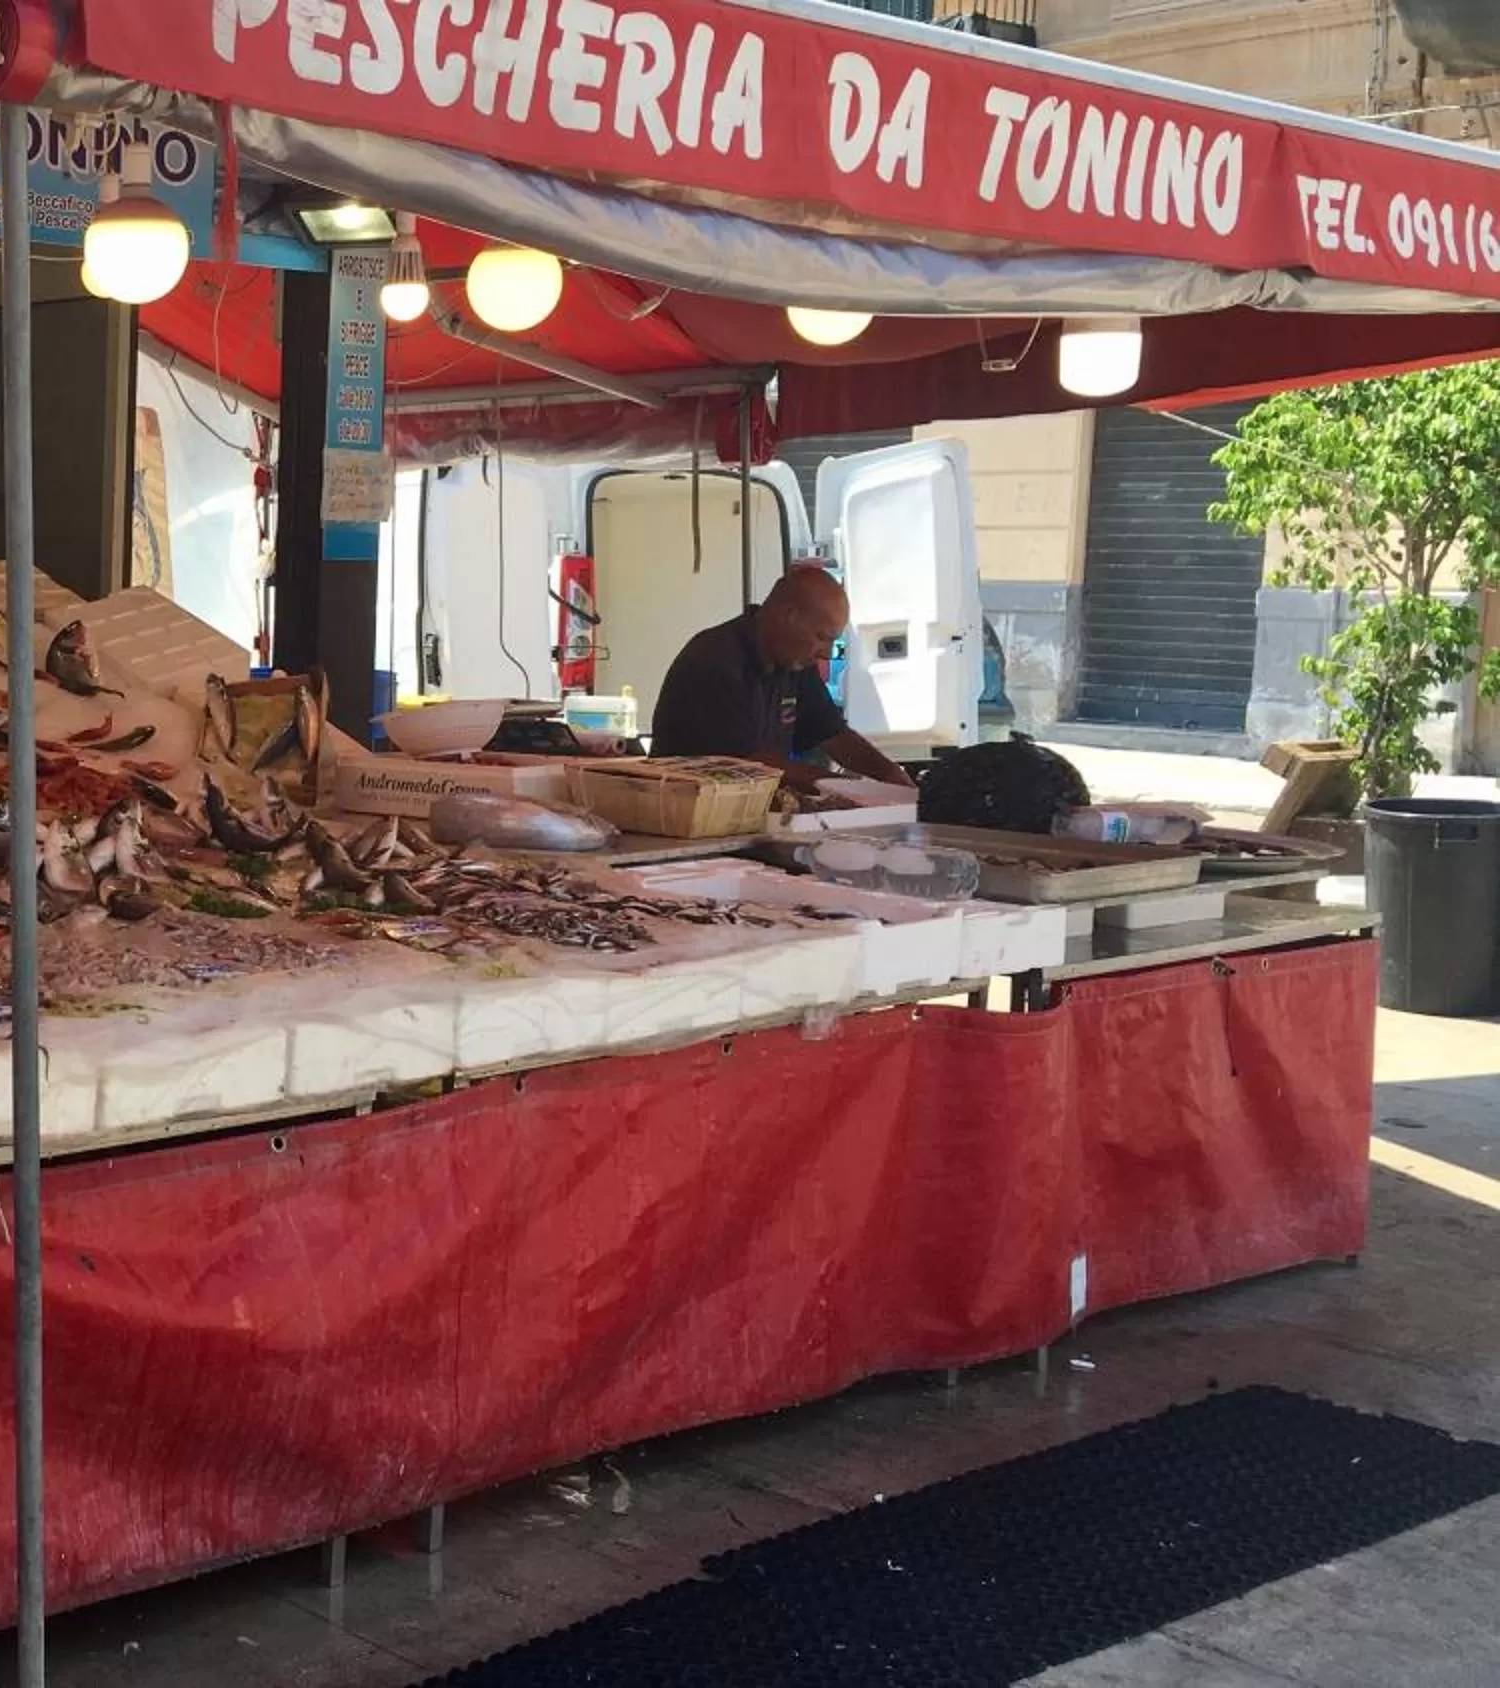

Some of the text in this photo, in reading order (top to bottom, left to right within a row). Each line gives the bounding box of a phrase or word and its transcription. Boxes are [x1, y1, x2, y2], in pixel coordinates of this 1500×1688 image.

[212, 0, 1243, 236] PESCHERIA DA TONINO
[1296, 174, 1375, 255] TEL.
